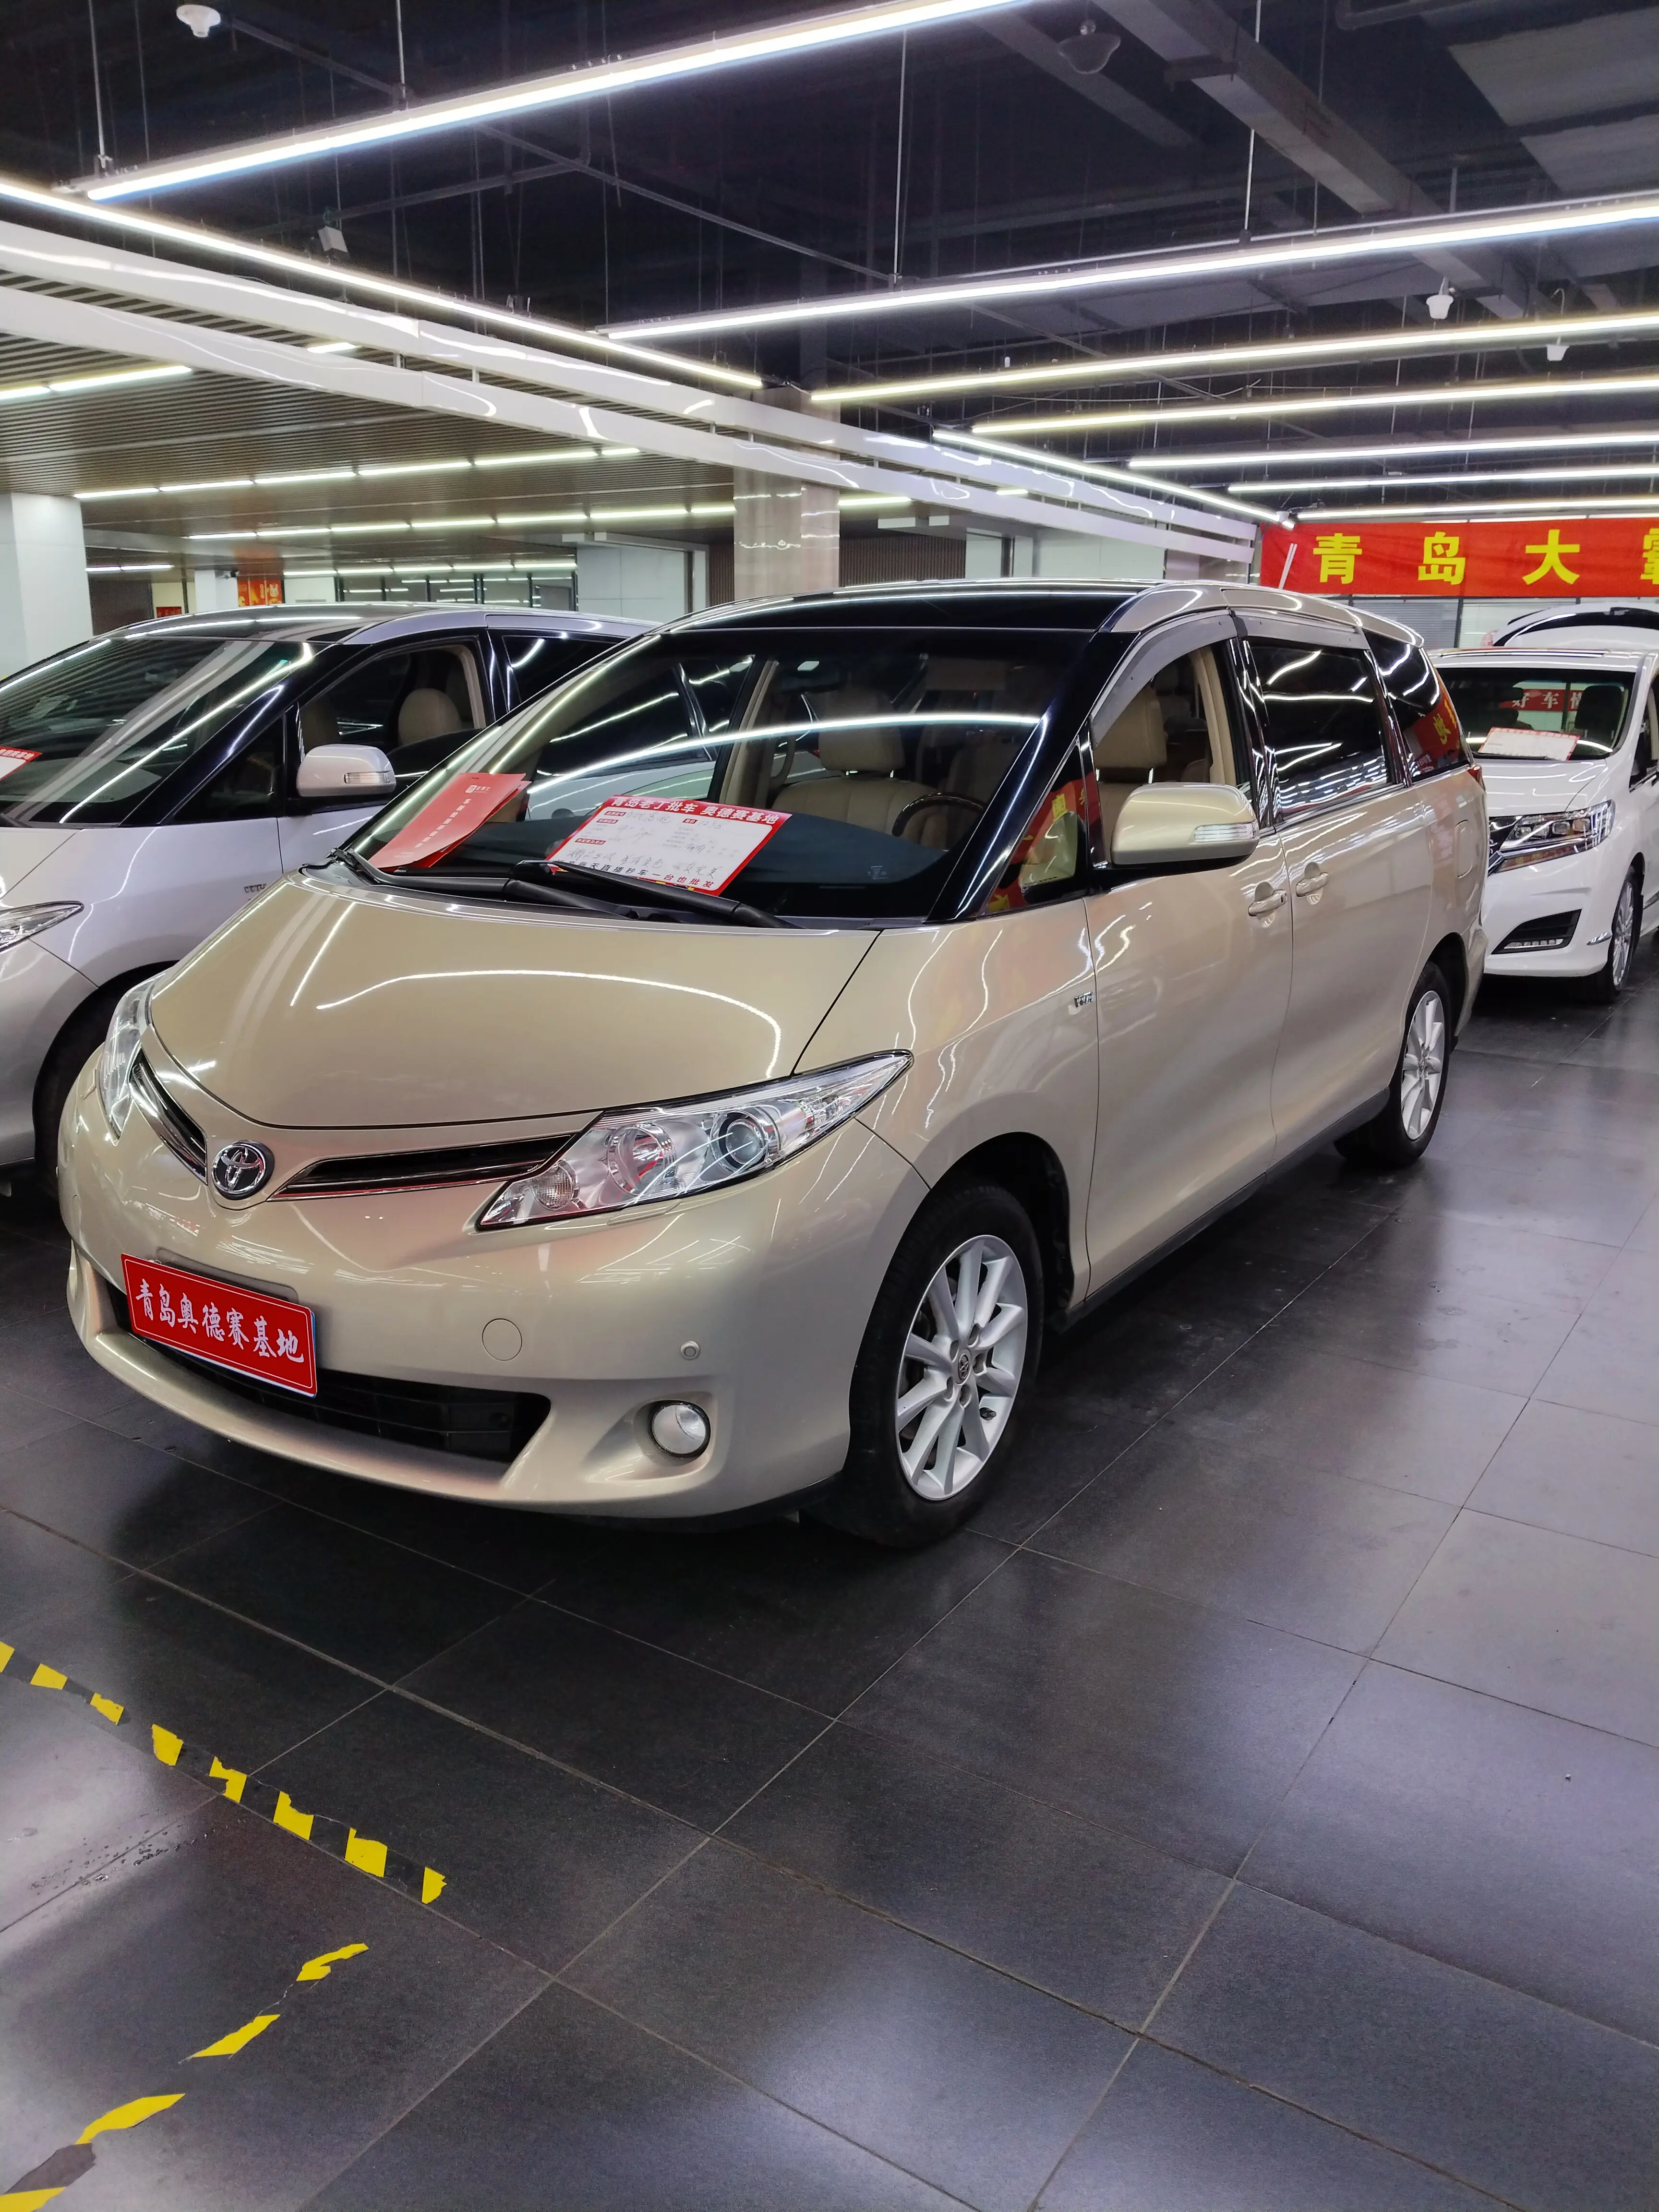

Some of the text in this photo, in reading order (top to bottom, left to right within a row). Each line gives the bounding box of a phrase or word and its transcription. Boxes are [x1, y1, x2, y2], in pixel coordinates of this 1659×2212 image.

[611, 797, 781, 825] 青岛老丁批车 奥德赛基地
[135, 1278, 304, 1363] 青岛奥德赛基地
